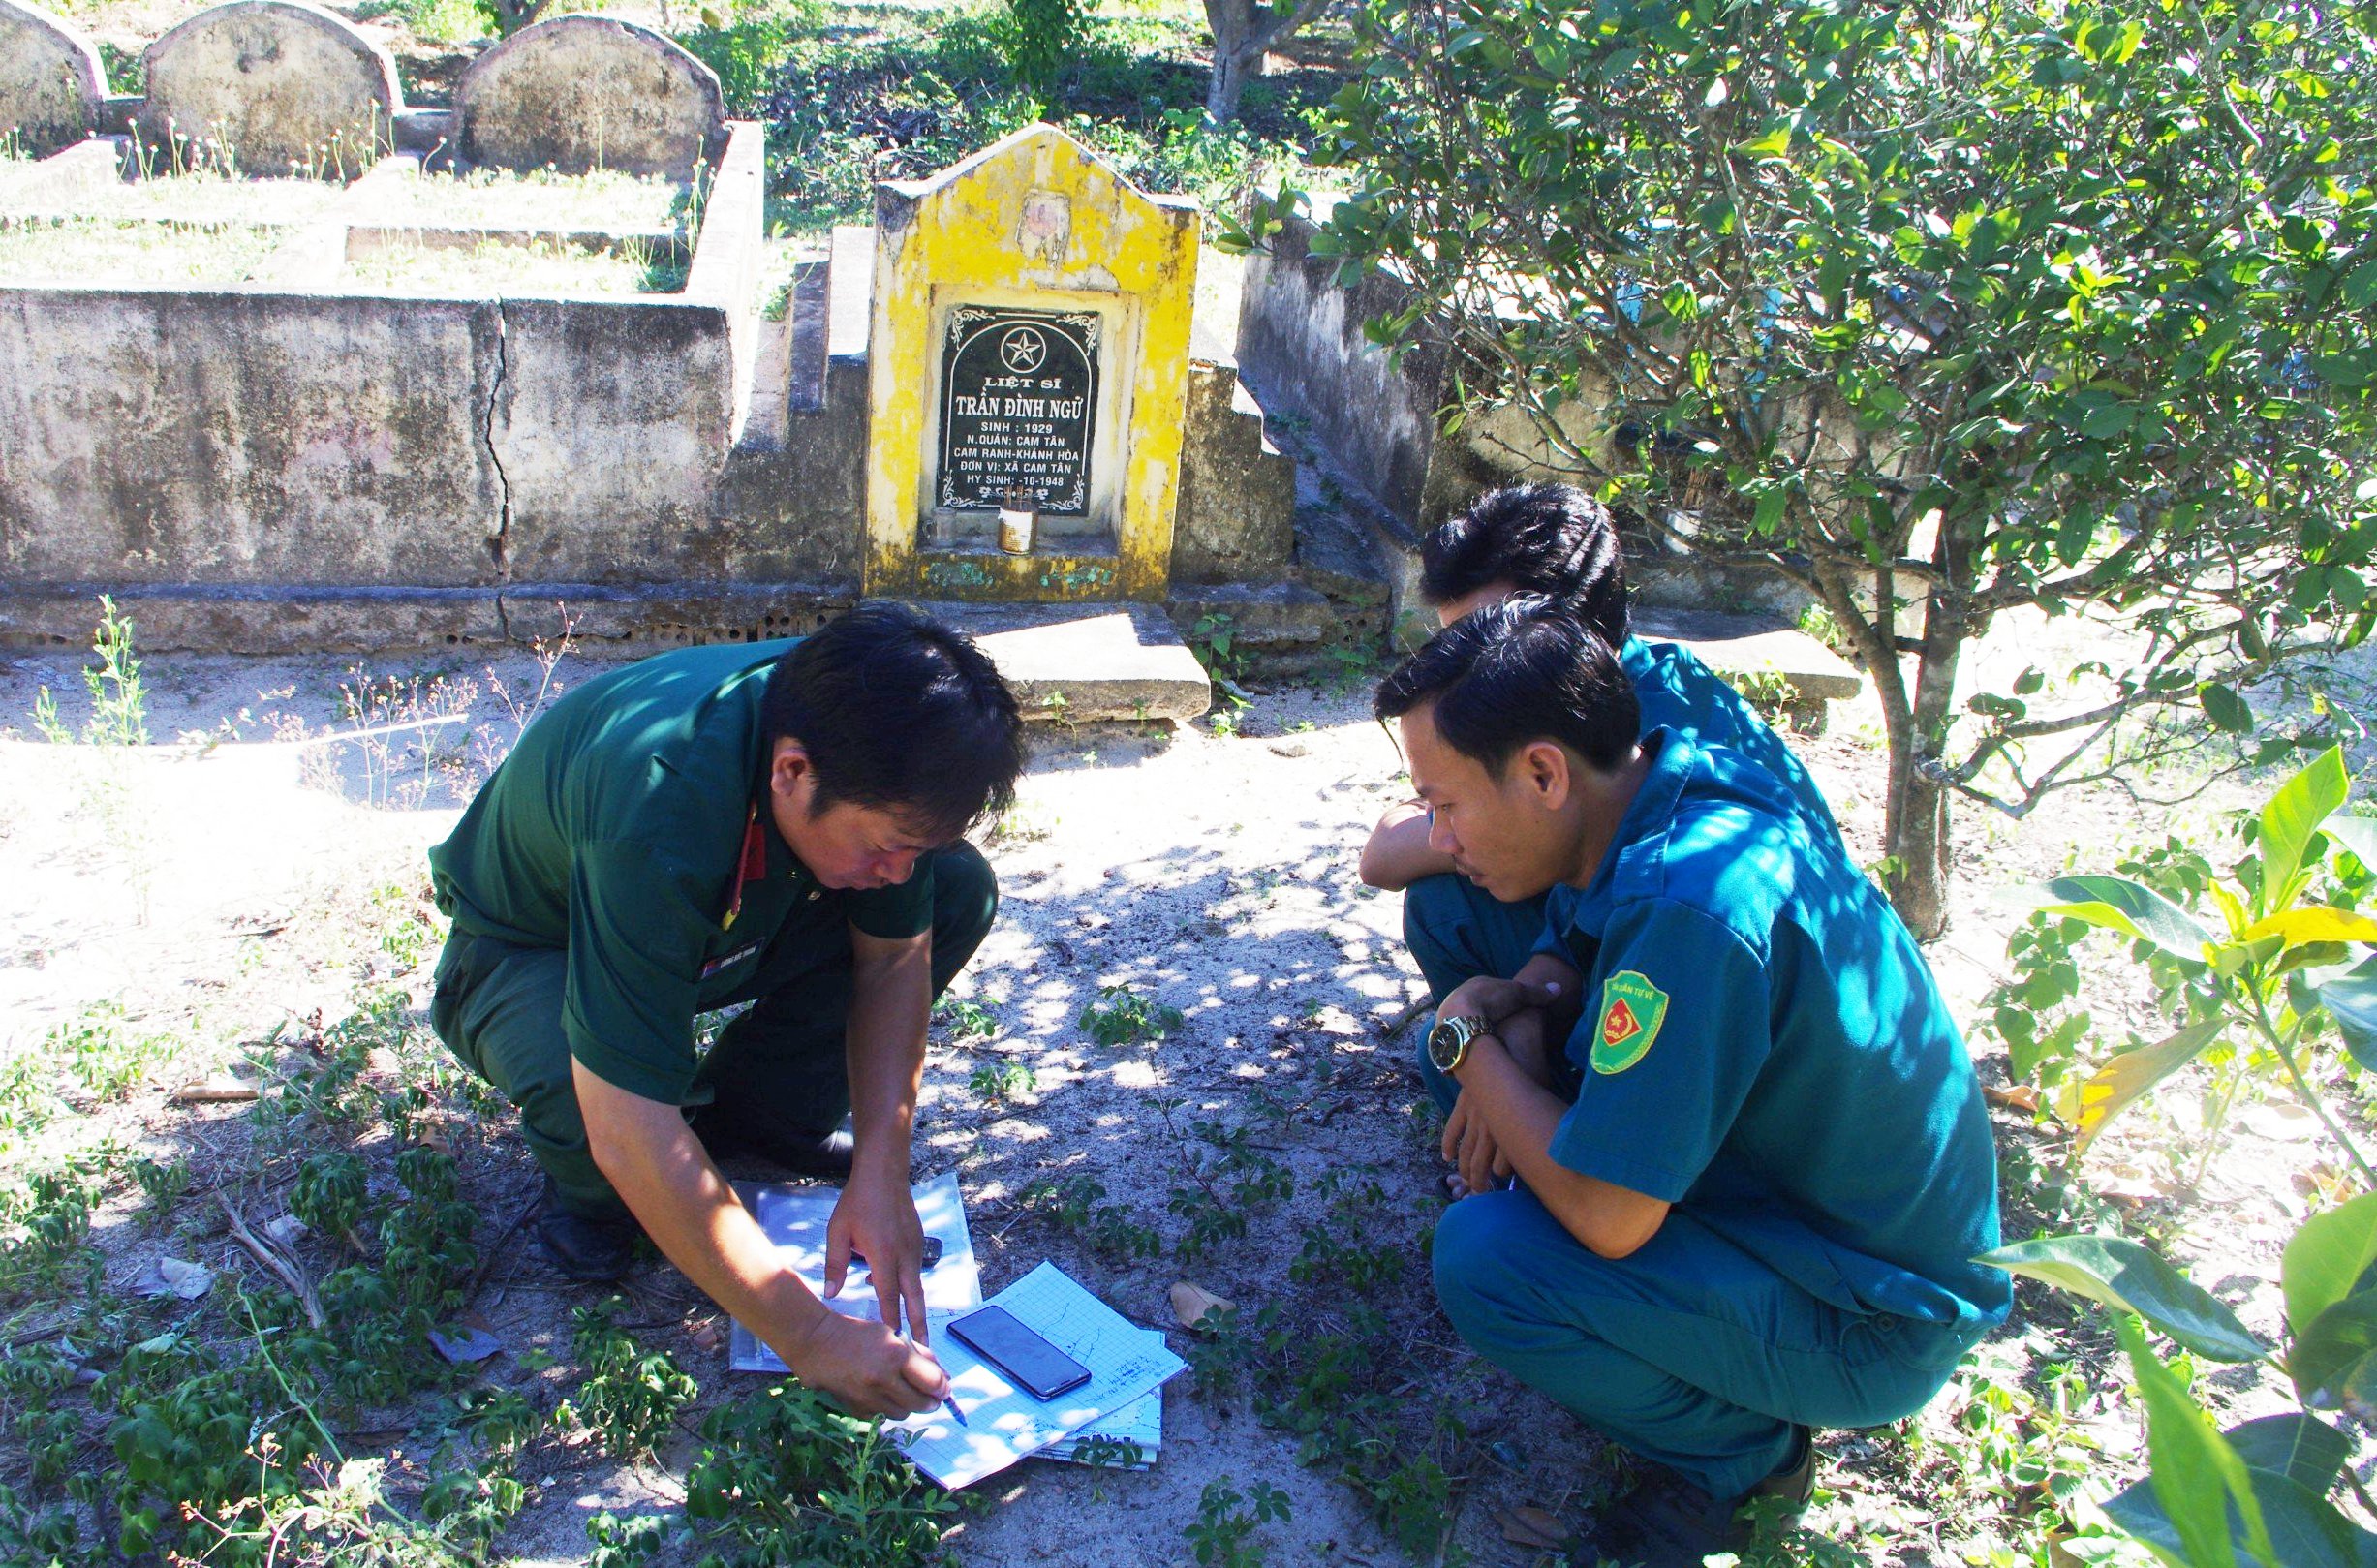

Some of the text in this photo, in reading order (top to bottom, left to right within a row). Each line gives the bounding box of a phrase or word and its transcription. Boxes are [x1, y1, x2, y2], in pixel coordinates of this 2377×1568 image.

[984, 375, 1034, 389] LIỆT
[956, 386, 1084, 419] TRẦN ĐÌNH NGỮ
[980, 421, 1010, 432] SINH
[1024, 423, 1053, 434] 1929
[1016, 436, 1039, 446] CAM
[1044, 435, 1065, 447] TÂN
[954, 446, 1079, 461] CAM RANH-KHÁNH HÒA
[960, 460, 1072, 474] ĐƠN VỊ: XÃ CAM TÂN
[967, 475, 981, 484] HY
[985, 475, 1014, 485] SINH:
